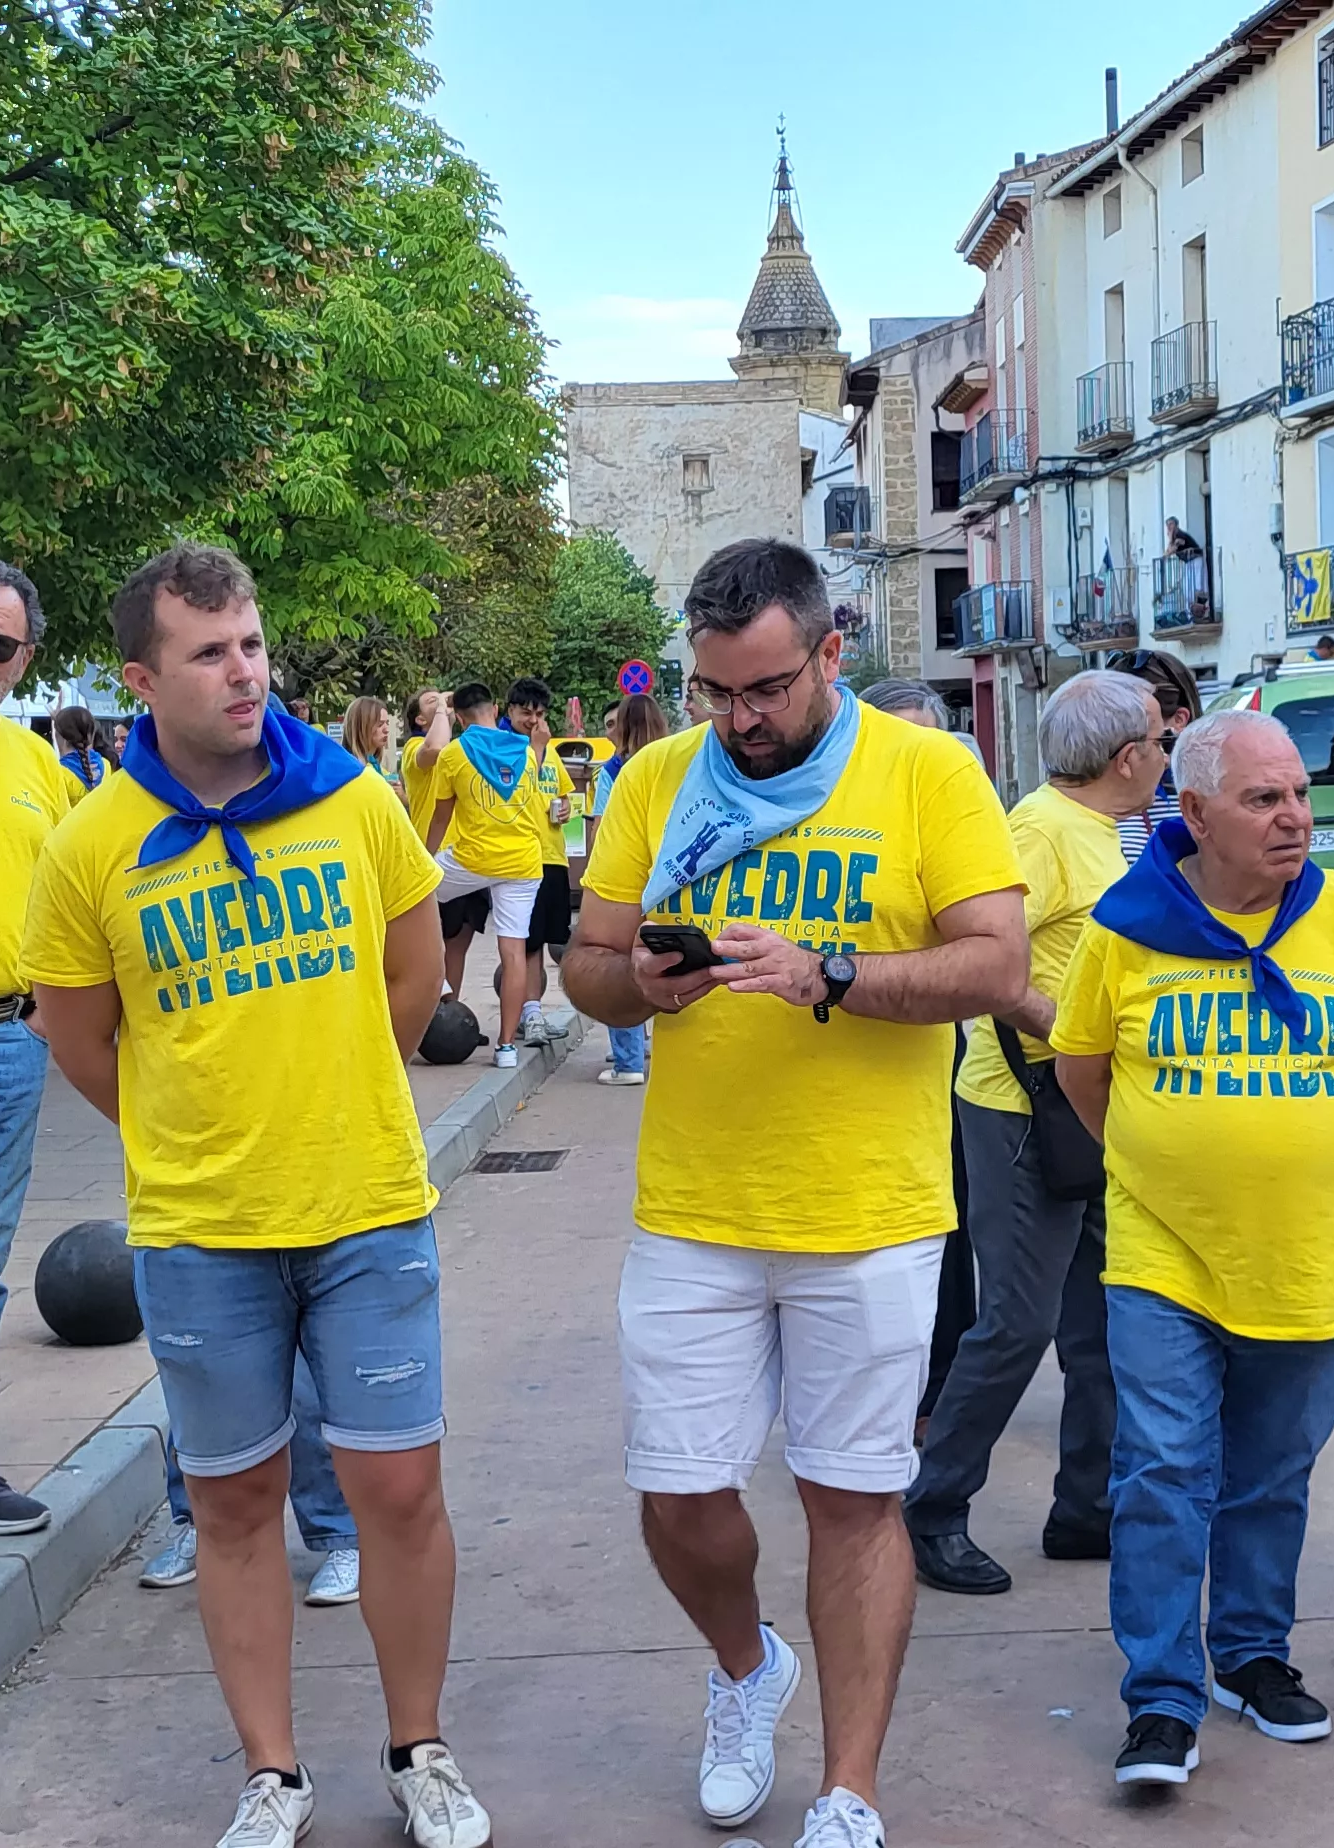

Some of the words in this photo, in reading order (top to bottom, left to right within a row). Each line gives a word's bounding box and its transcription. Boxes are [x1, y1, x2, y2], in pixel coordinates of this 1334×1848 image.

[680, 797, 724, 826] FIESTAS
[192, 848, 276, 878] FIESAS
[674, 916, 725, 932] SANT
[175, 953, 241, 980] SANTA
[253, 933, 336, 960] LETICIA
[1168, 1057, 1235, 1069] SANTA
[1247, 1057, 1325, 1070] LETICIA
